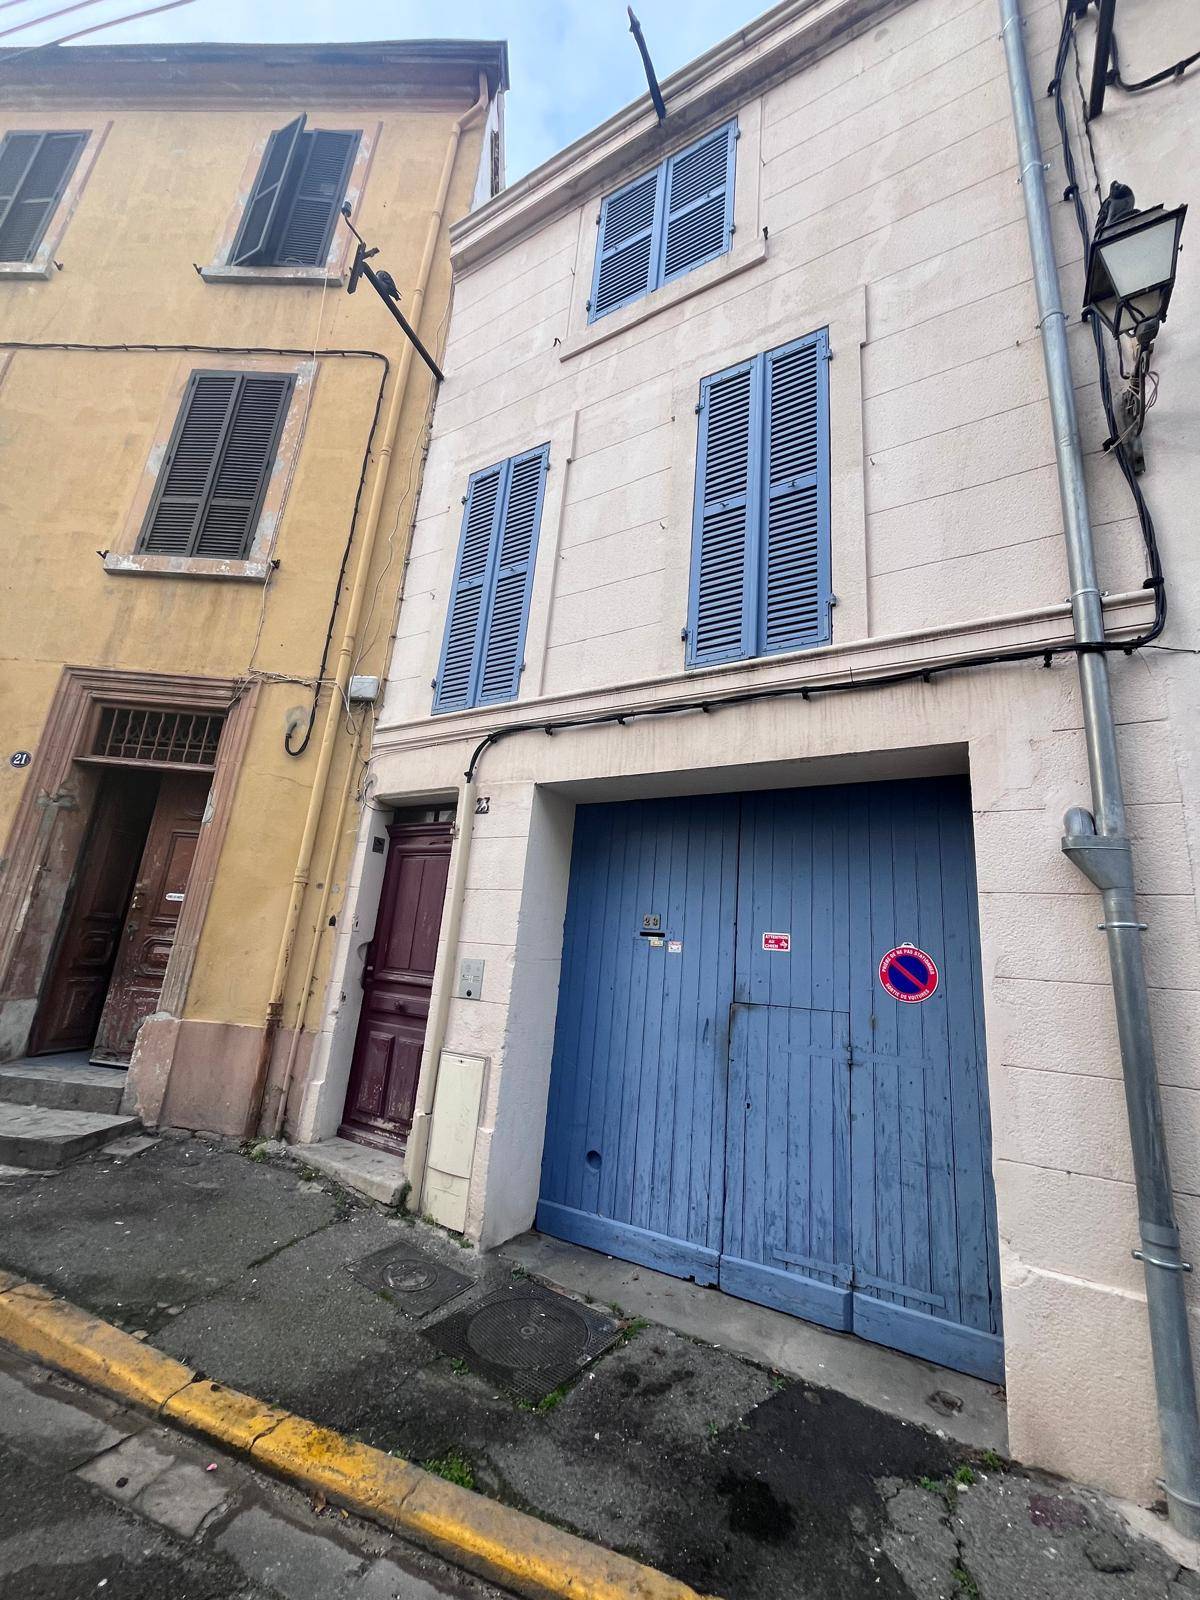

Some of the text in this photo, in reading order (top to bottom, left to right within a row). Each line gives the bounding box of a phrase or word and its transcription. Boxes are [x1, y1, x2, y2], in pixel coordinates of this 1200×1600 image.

[13, 753, 27, 764] 21
[885, 983, 900, 997] SORTIE
[908, 989, 930, 1000] VOITURES
